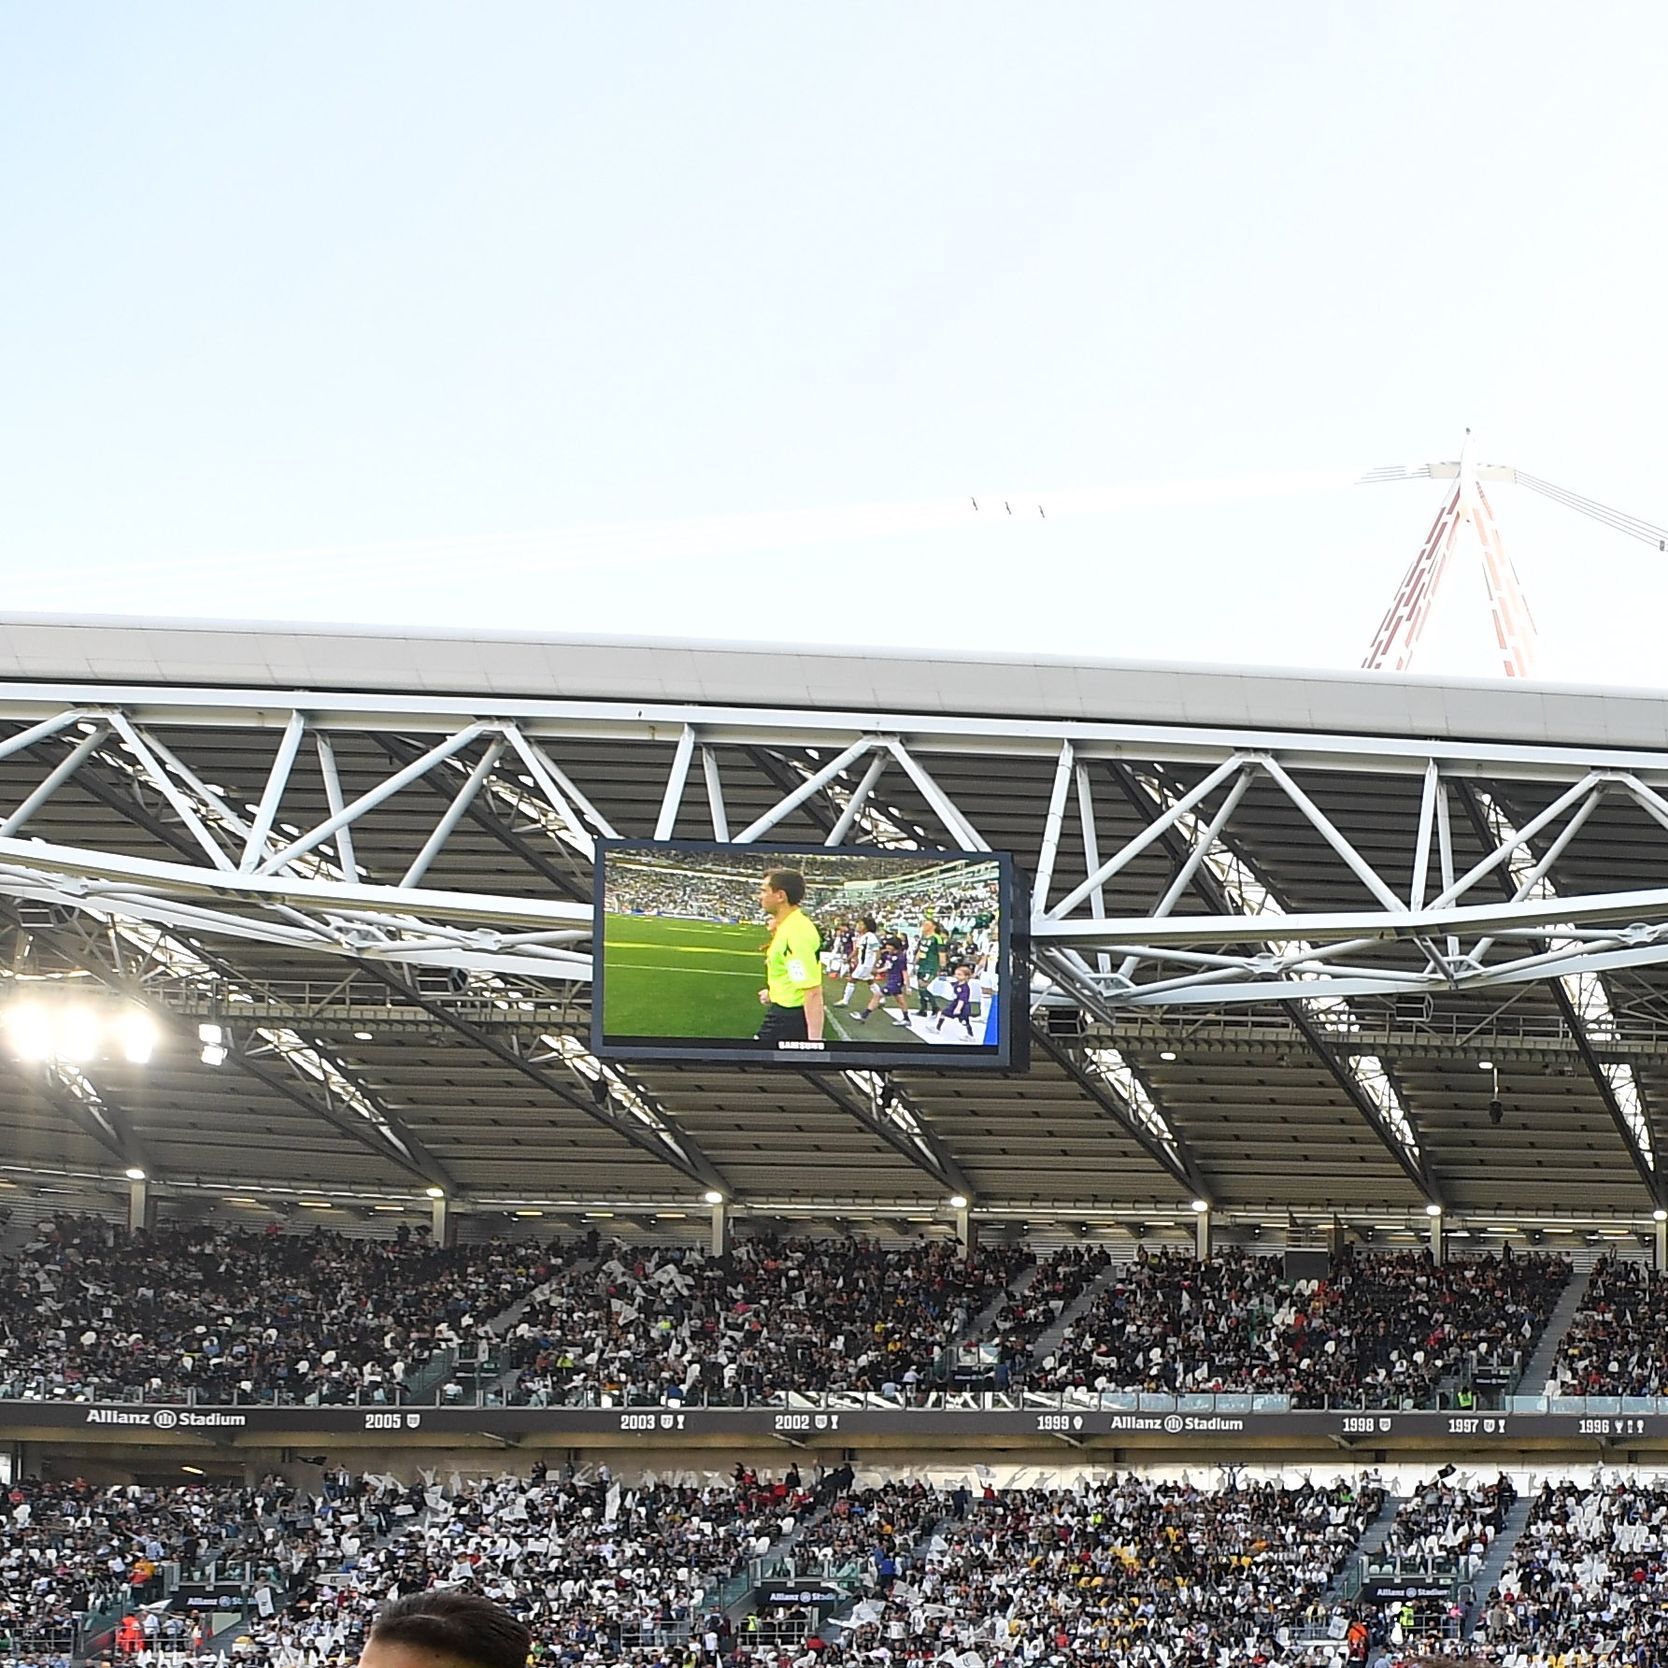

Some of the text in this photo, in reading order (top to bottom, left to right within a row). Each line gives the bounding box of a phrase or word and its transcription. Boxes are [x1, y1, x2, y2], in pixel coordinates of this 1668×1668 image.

[87, 1410, 245, 1427] Allianz Stadium
[365, 1414, 401, 1429] 2005
[621, 1415, 655, 1430] 2003
[775, 1415, 809, 1430] 2002
[1037, 1415, 1069, 1430] 1999
[1111, 1415, 1243, 1431] Allianz Stadium
[1342, 1418, 1374, 1433] 1998
[1448, 1419, 1478, 1433] 1997
[1579, 1419, 1609, 1434] 1996
